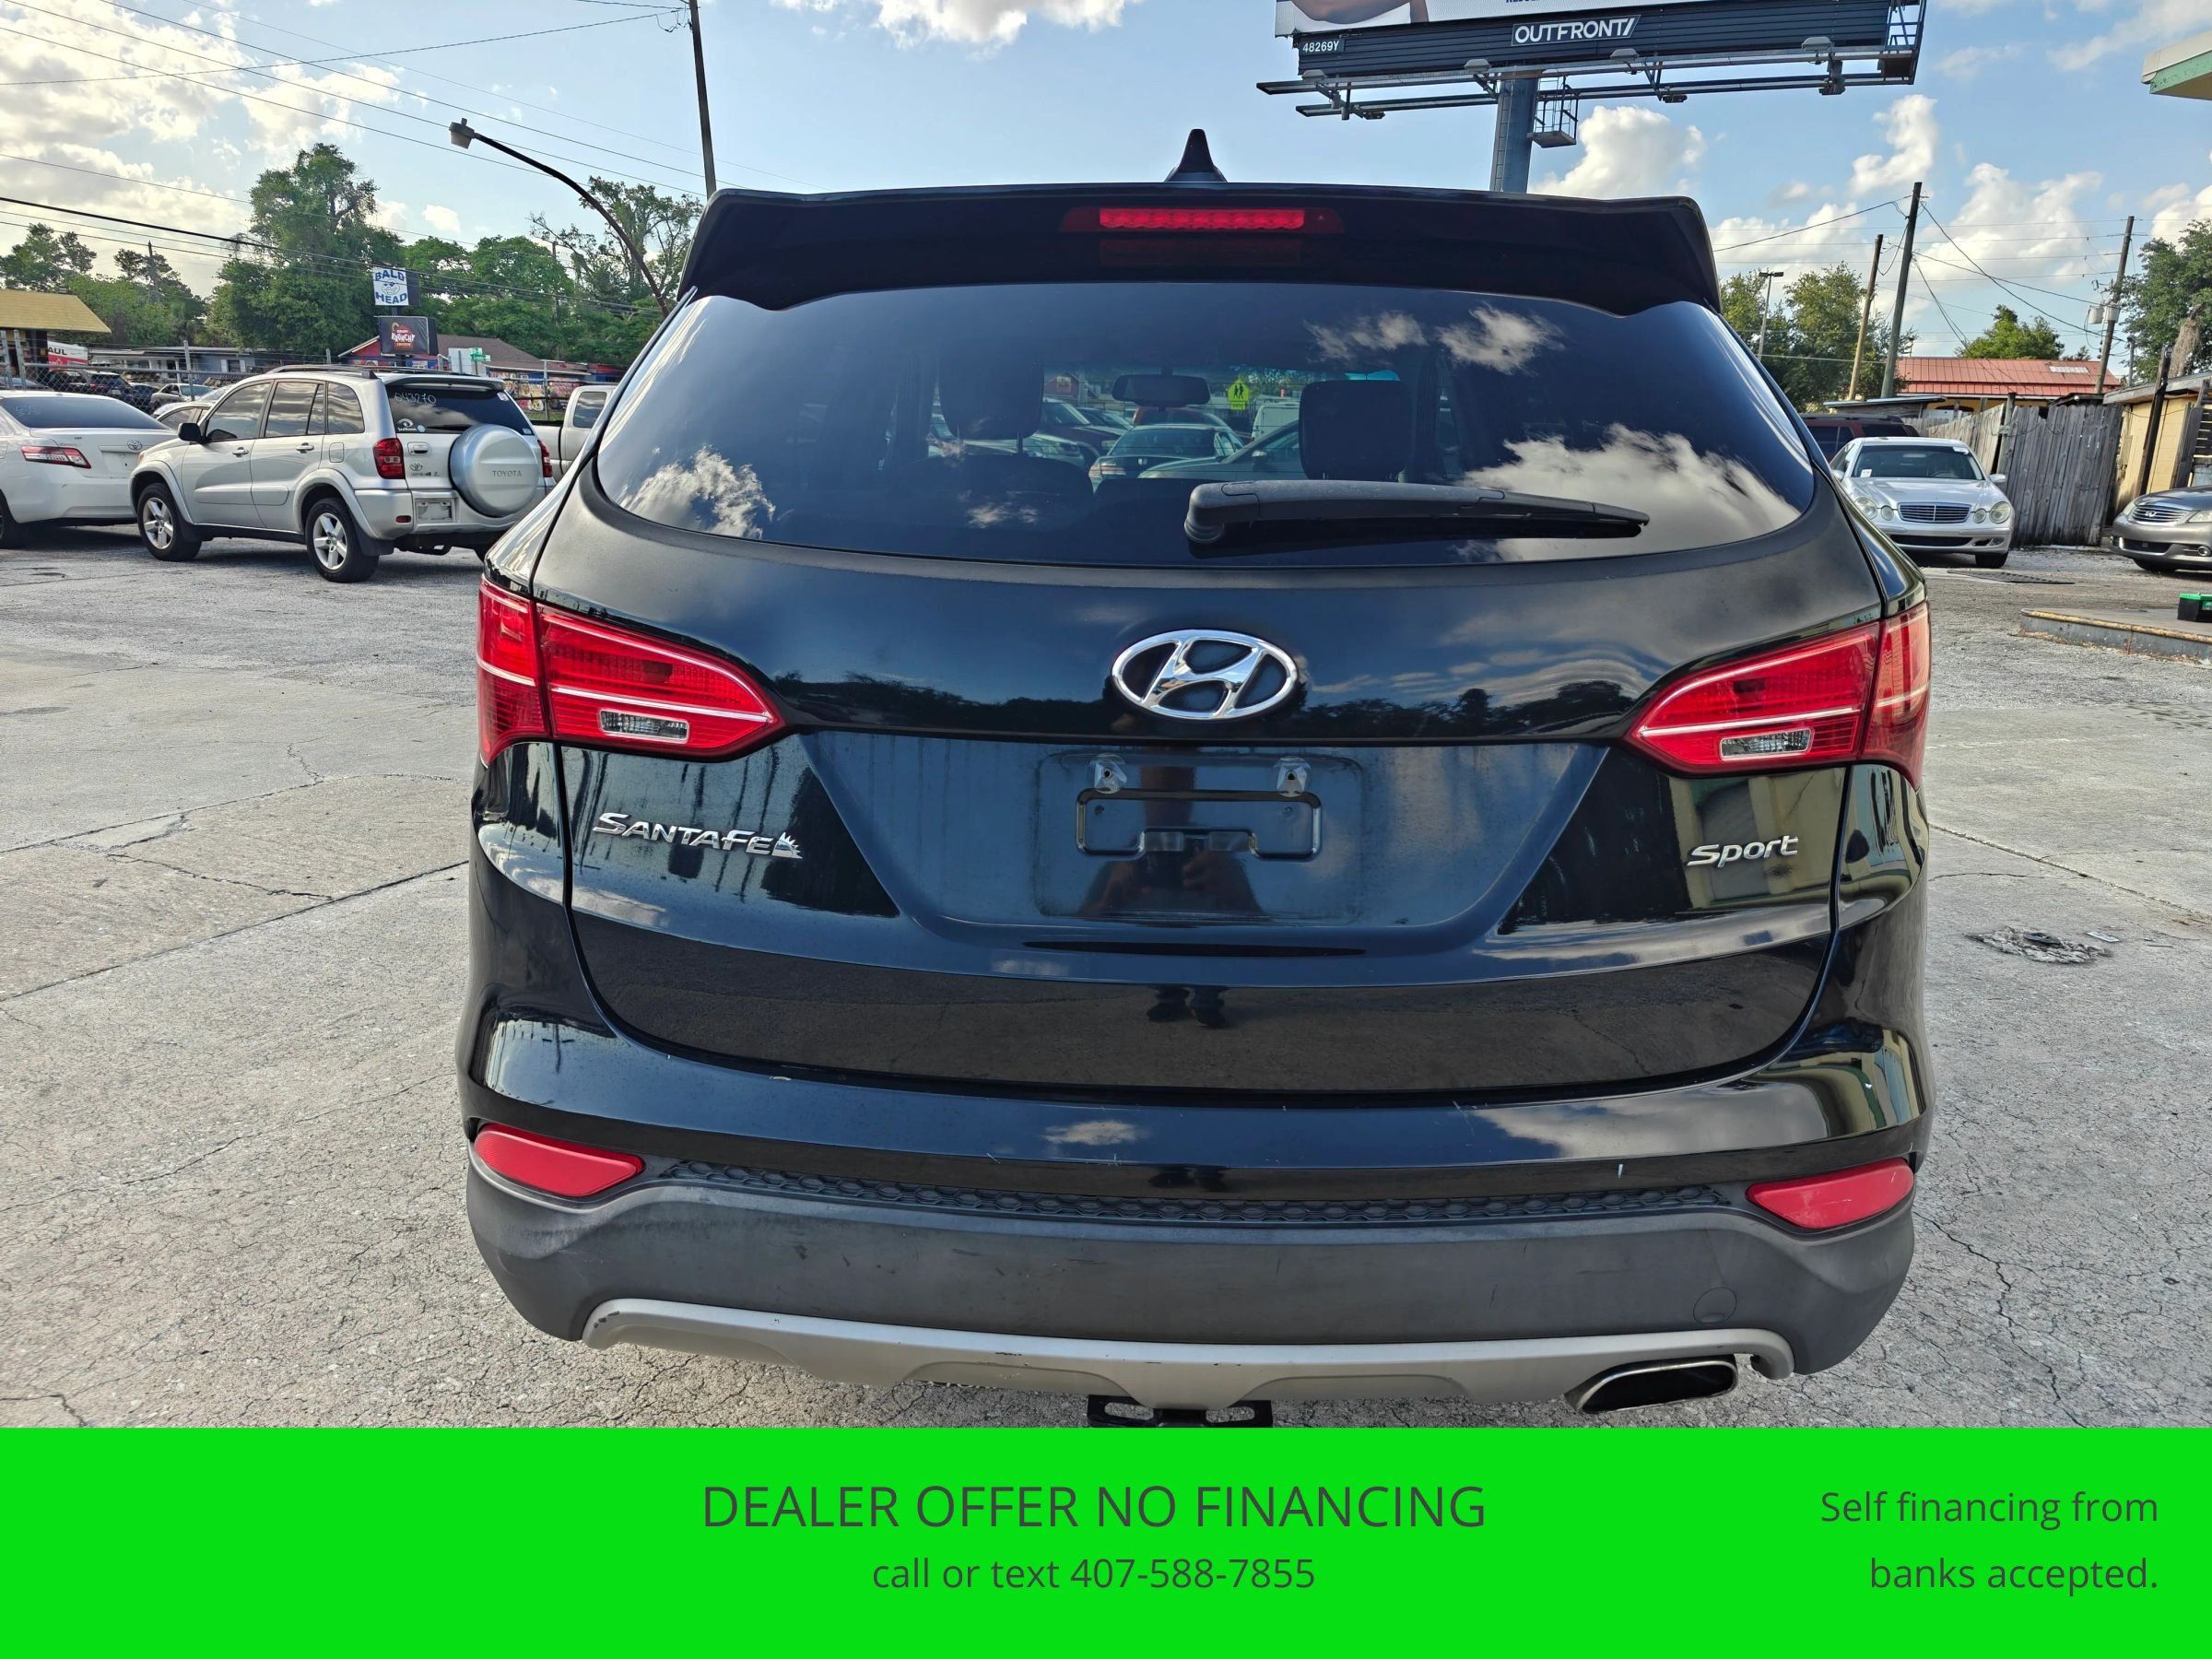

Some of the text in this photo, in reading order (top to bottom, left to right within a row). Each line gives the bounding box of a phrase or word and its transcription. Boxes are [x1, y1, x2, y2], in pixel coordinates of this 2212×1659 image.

[1302, 41, 1340, 53] 48269Y
[375, 269, 405, 281] BALD
[375, 291, 407, 304] HEAD
[1687, 835, 1799, 868] Sport
